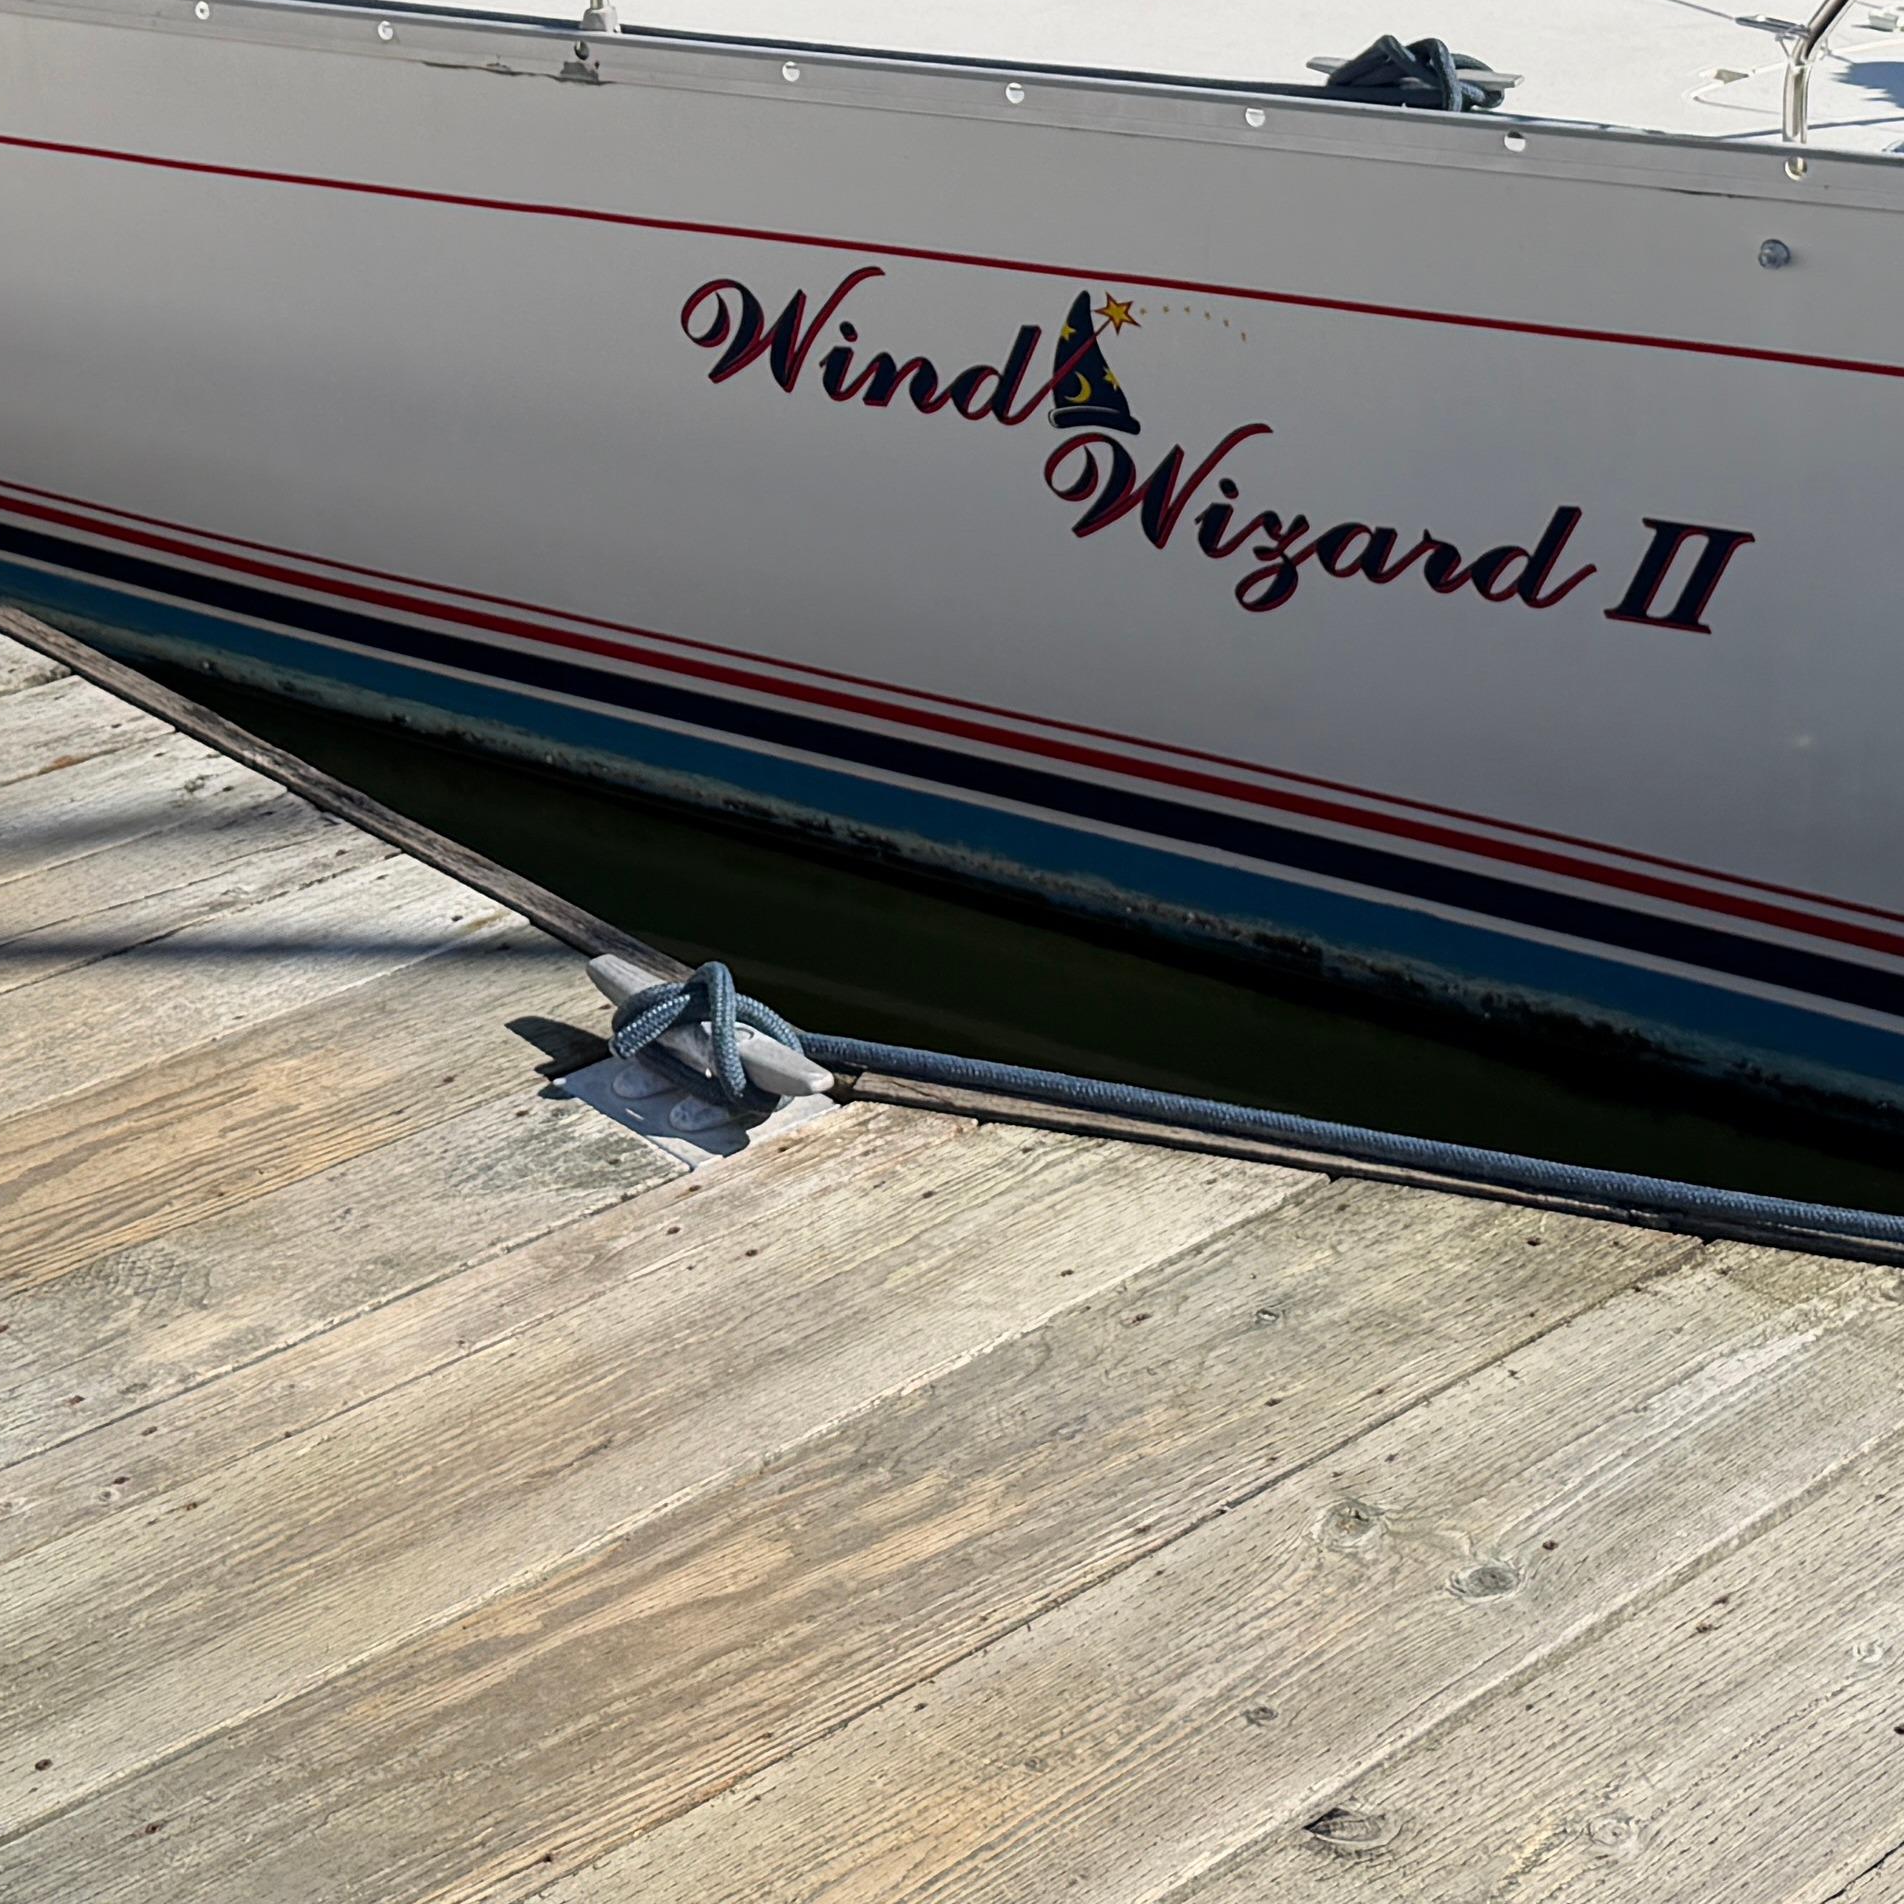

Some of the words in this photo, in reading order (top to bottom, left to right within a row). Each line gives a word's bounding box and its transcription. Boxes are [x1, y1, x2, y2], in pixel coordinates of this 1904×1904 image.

[680, 265, 1044, 427] Wind
[1042, 422, 1598, 614] Wizard
[1602, 515, 1757, 636] II
